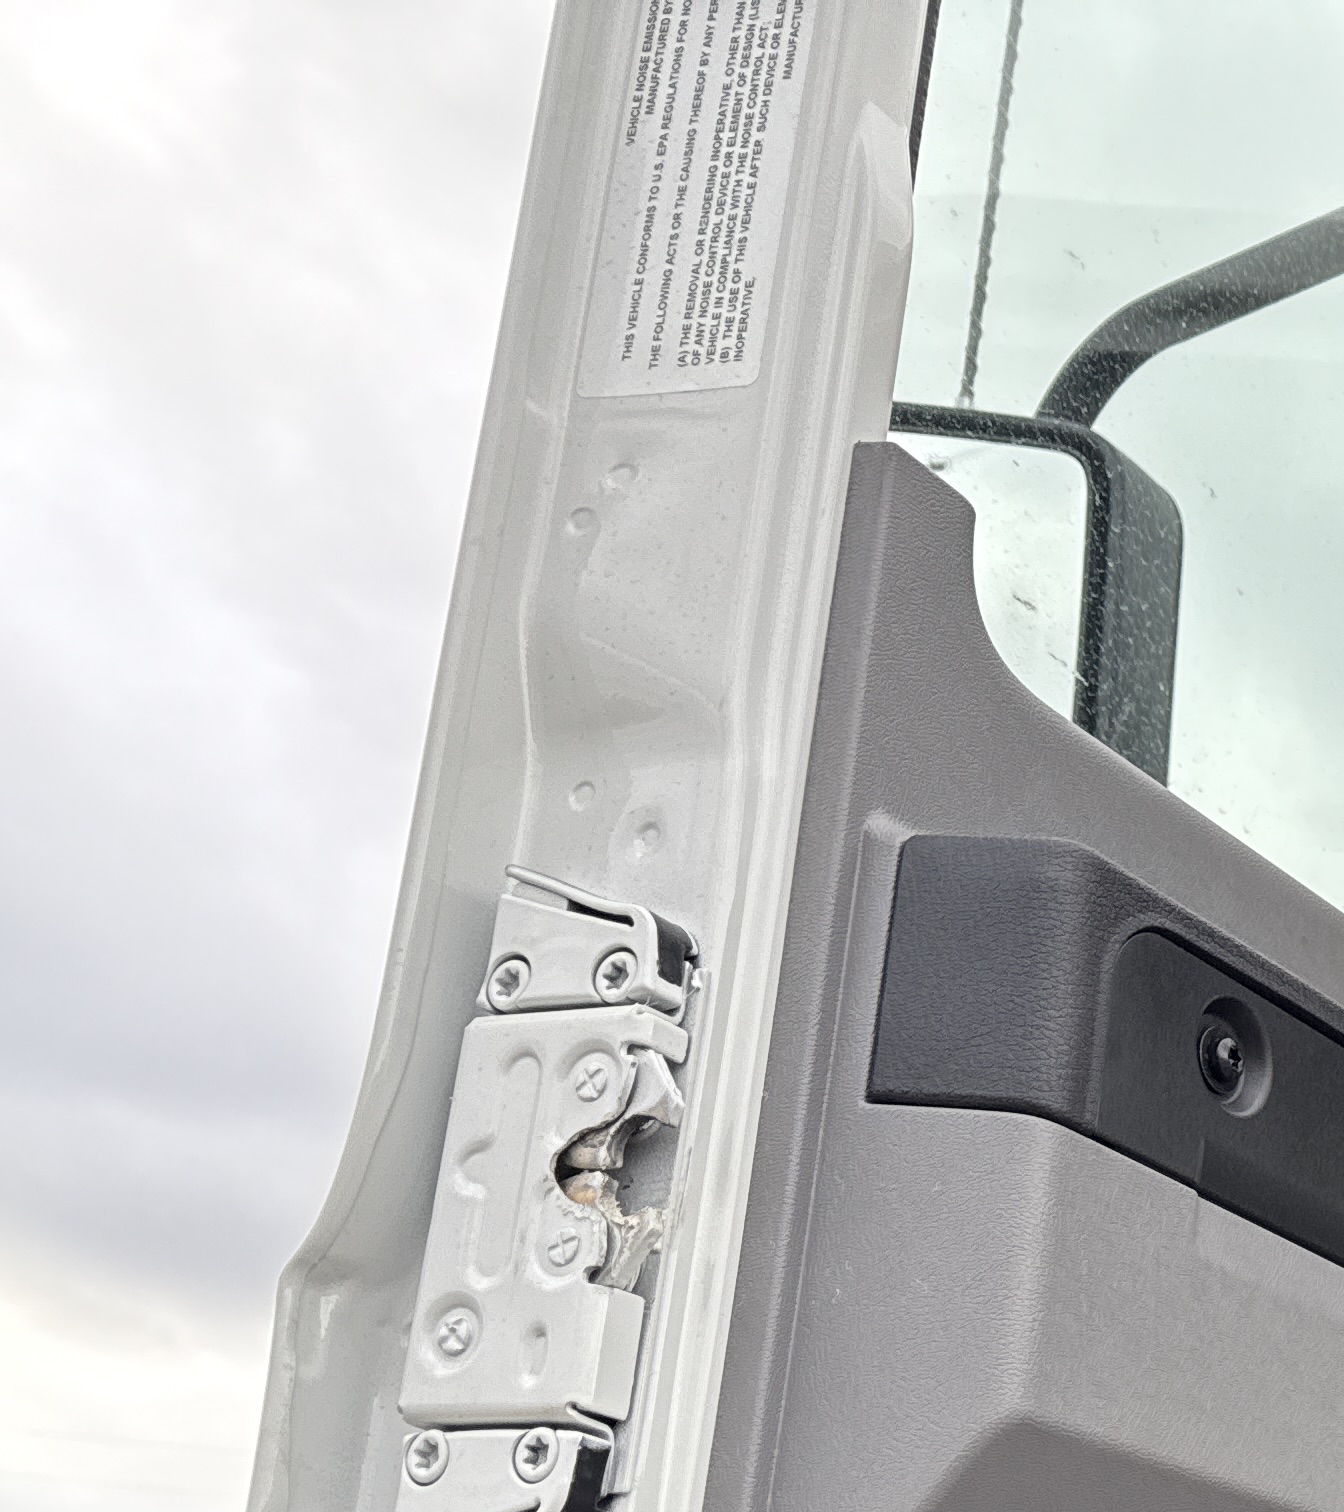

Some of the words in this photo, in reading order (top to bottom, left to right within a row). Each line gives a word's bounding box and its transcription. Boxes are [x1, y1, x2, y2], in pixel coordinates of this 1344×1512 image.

[675, 18, 690, 44] FOR
[731, 0, 747, 34] THAN
[702, 24, 716, 49] ANY
[739, 23, 757, 69] DESIGN
[769, 31, 782, 50] OR
[644, 17, 671, 115] MANUFACTURED
[662, 0, 674, 15] BY
[699, 50, 711, 67] BY
[724, 34, 741, 77] OTHER
[660, 45, 685, 130] REGULATIONS
[736, 71, 748, 88] OF
[746, 51, 766, 110] CONTROL
[762, 52, 779, 97] DEVICE
[624, 94, 644, 147] VEHICLE
[634, 55, 651, 92] NOISE
[688, 69, 707, 126] THEREOF
[726, 90, 745, 148] ELEMENT
[739, 111, 755, 149] NOISE
[756, 99, 771, 133] SUCH
[655, 132, 670, 157] EPA
[679, 128, 698, 183] CAUSING
[722, 150, 735, 169] OR
[651, 159, 665, 183] U.S.
[734, 151, 749, 177] THE
[647, 185, 660, 203] TO
[674, 184, 688, 210] THE
[697, 164, 719, 236] RENDERING
[714, 170, 732, 216] DEVICE
[729, 178, 744, 211] WITH
[739, 180, 758, 234] VEHICLE
[671, 211, 683, 231] OR
[635, 205, 657, 275] CONFORMS
[664, 232, 680, 266] ACTS
[694, 238, 706, 257] OR
[704, 218, 724, 278] CONTROL
[715, 212, 738, 294] COMPLIANCE
[733, 235, 748, 265] THIS
[683, 258, 703, 320] REMOVAL
[731, 267, 743, 285] OF
[625, 277, 645, 331] VEHICLE
[652, 268, 674, 342] FOLLOWING
[697, 279, 714, 319] NOISE
[713, 296, 725, 309] IN
[726, 286, 740, 313] USE
[678, 322, 693, 348] THE
[693, 321, 707, 348] ANY
[704, 311, 722, 366] VEHICLE
[721, 315, 736, 341] THE
[621, 333, 635, 362] THIS
[647, 343, 662, 371] THE
[676, 350, 691, 368] (A)
[690, 349, 702, 367] OF
[718, 346, 733, 364] (B)
